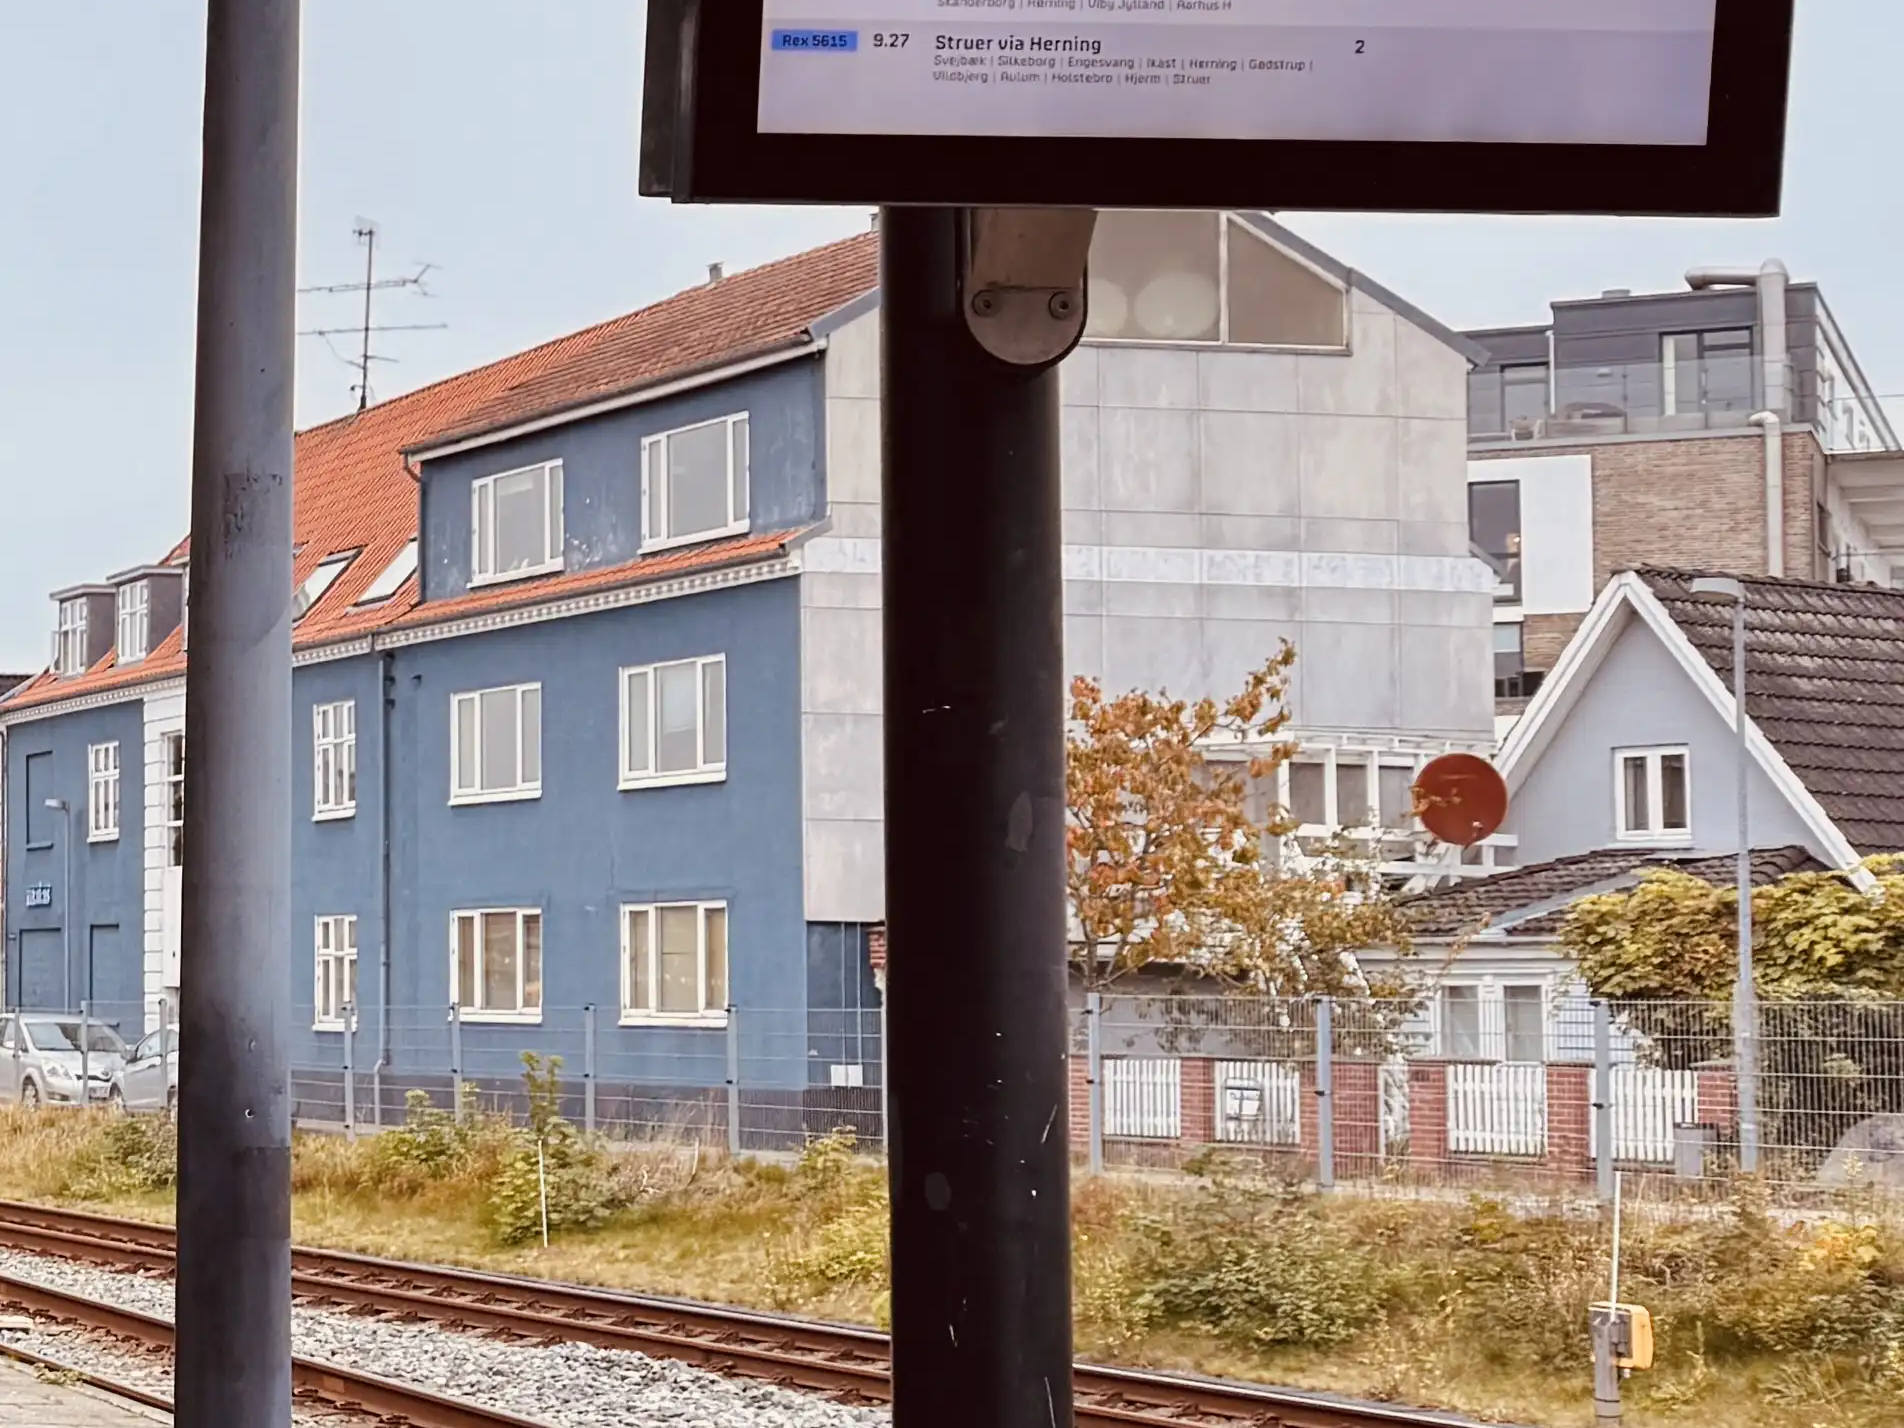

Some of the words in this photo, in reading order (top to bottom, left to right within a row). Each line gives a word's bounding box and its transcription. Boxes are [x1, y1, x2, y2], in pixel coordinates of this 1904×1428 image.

[783, 35, 808, 46] Rex
[813, 35, 847, 47] 5615
[874, 34, 909, 47] 9.27
[936, 35, 993, 50] Struer
[999, 35, 1024, 50] via
[1030, 36, 1101, 54] Herning
[1355, 40, 1364, 53] 2
